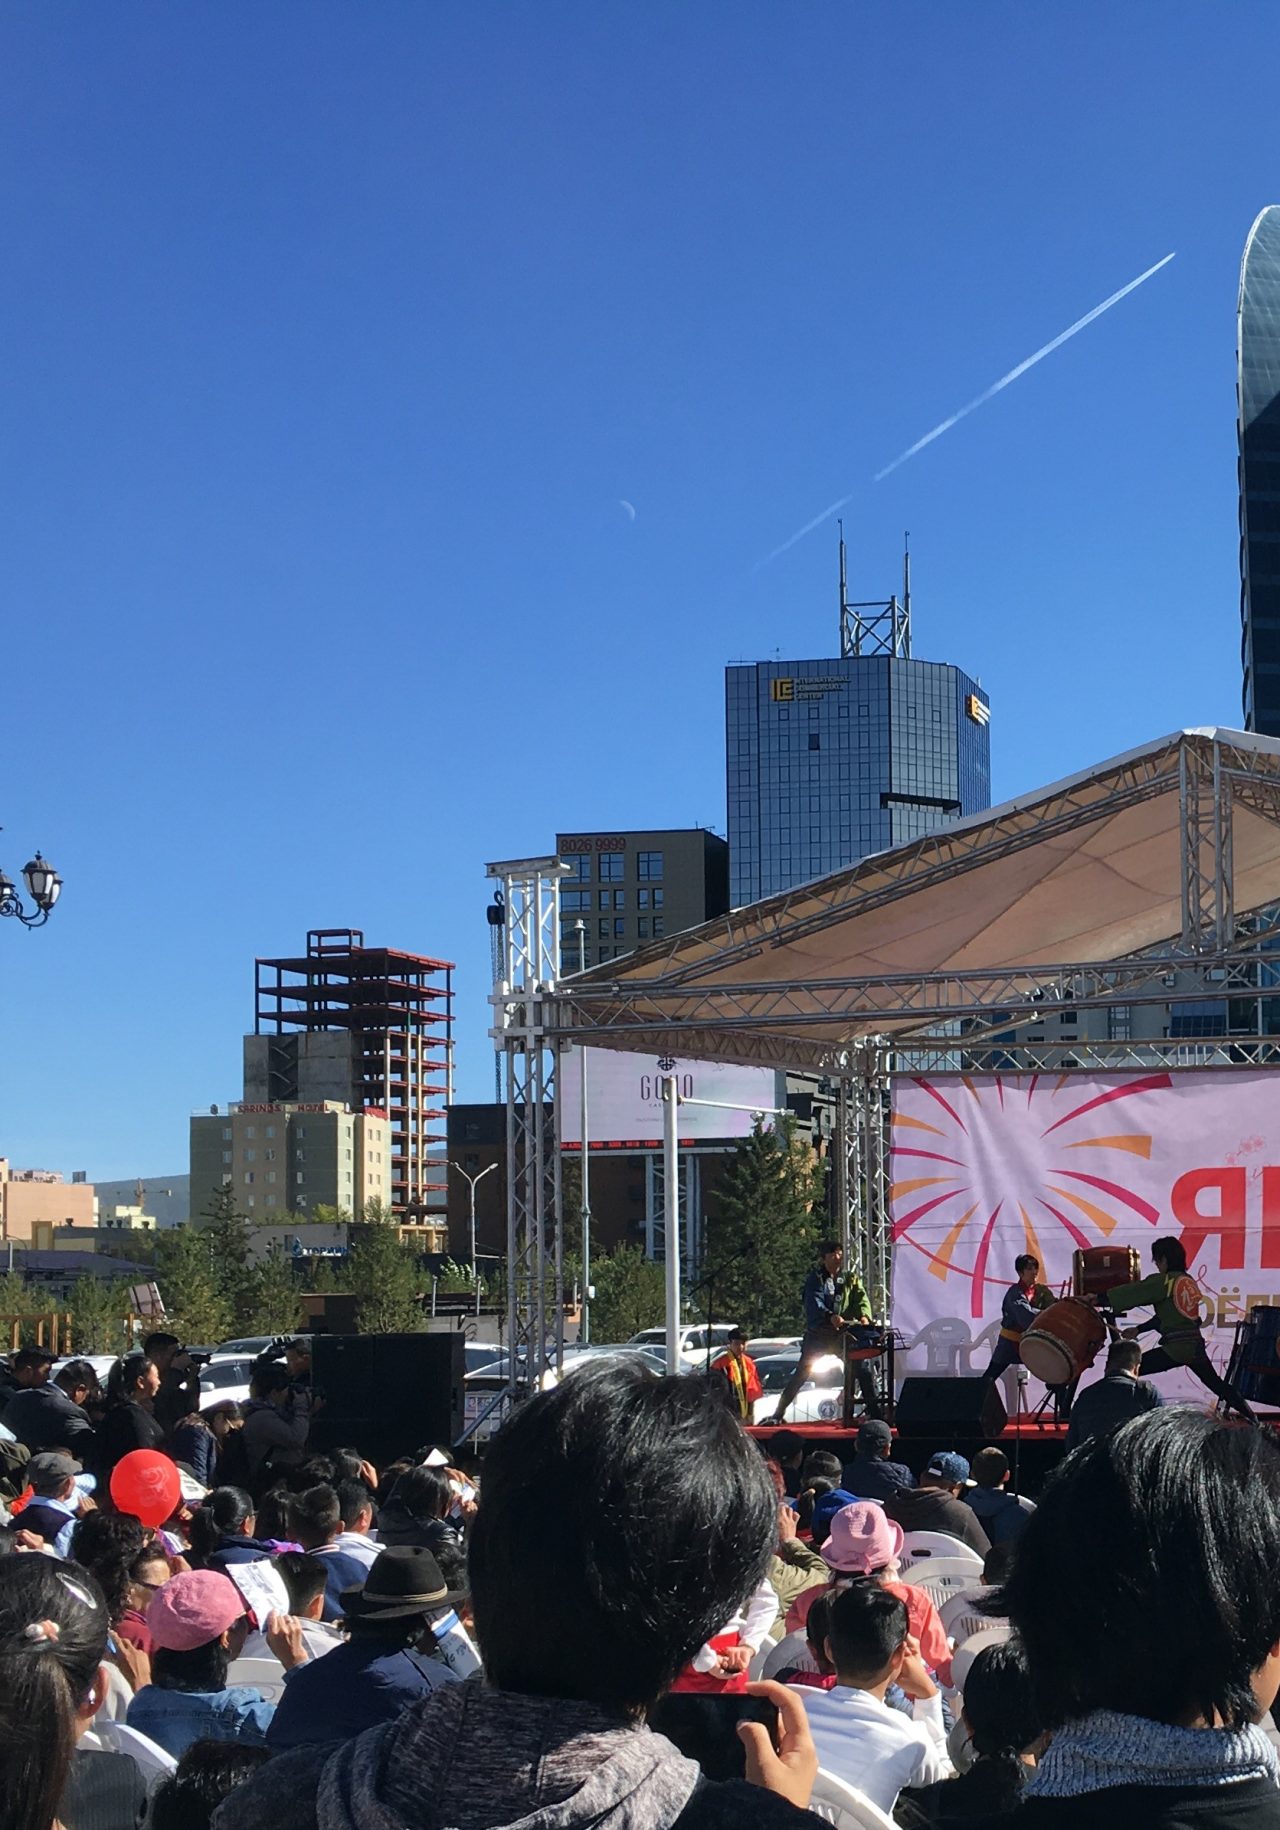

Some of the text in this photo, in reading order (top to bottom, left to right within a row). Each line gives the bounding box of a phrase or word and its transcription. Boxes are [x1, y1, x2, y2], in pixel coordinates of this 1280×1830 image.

[560, 837, 626, 853] 8026 9999
[641, 1074, 693, 1100] GOO
[298, 1103, 330, 1112] HOTEL
